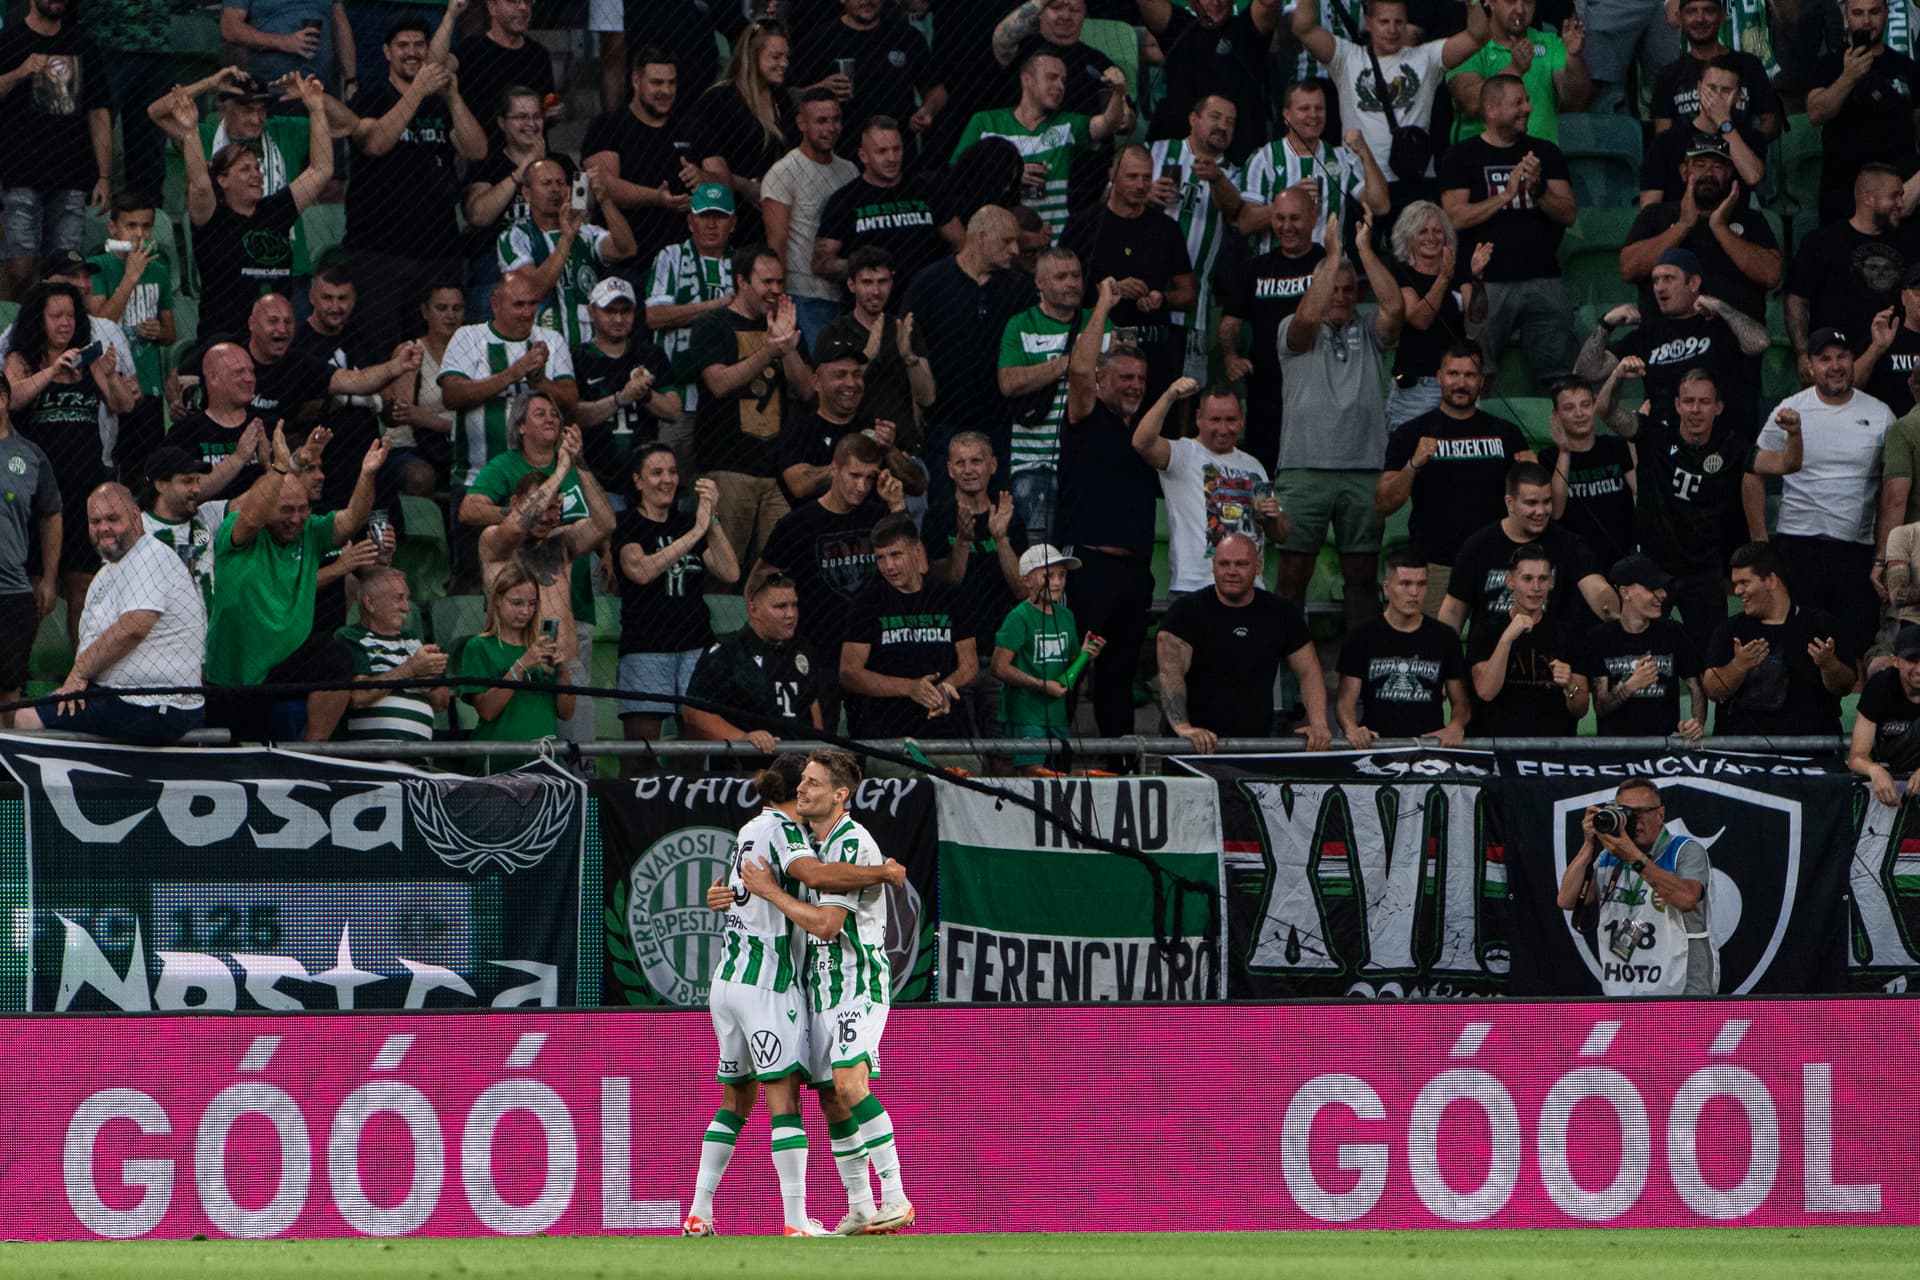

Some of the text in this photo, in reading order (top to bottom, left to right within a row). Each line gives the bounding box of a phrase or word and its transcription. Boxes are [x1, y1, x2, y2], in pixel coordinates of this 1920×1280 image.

[856, 211, 934, 233] ANTI VIOLA
[1256, 275, 1312, 297] XVI.SZEKT
[882, 627, 952, 645] ANTI VIOLA
[630, 777, 918, 818] BIATOGY
[1034, 778, 1169, 850] IKLAD
[1604, 919, 1656, 950] 18
[946, 927, 1217, 1002] FERENCVARO
[1604, 962, 1662, 983] HOTO
[838, 1018, 857, 1044] 16
[63, 1020, 1882, 1238] GÓÓÓL GÓÓÓL
